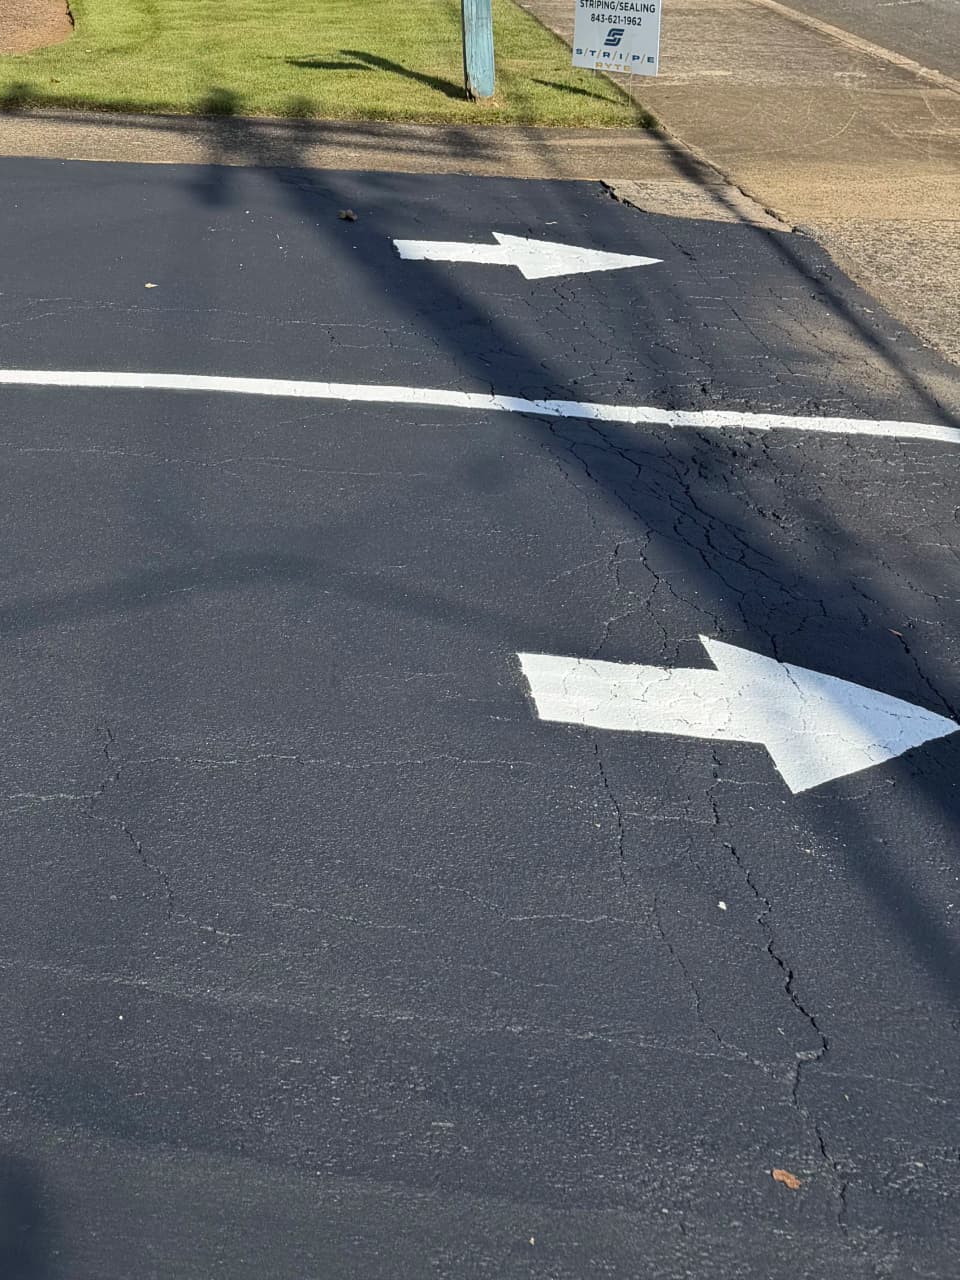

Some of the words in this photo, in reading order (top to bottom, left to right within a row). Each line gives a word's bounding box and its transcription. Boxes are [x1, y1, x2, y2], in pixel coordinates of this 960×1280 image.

[579, 0, 656, 13] STRIPING/SEALING
[590, 13, 642, 26] 843-621-1962
[595, 62, 632, 72] RYTE
